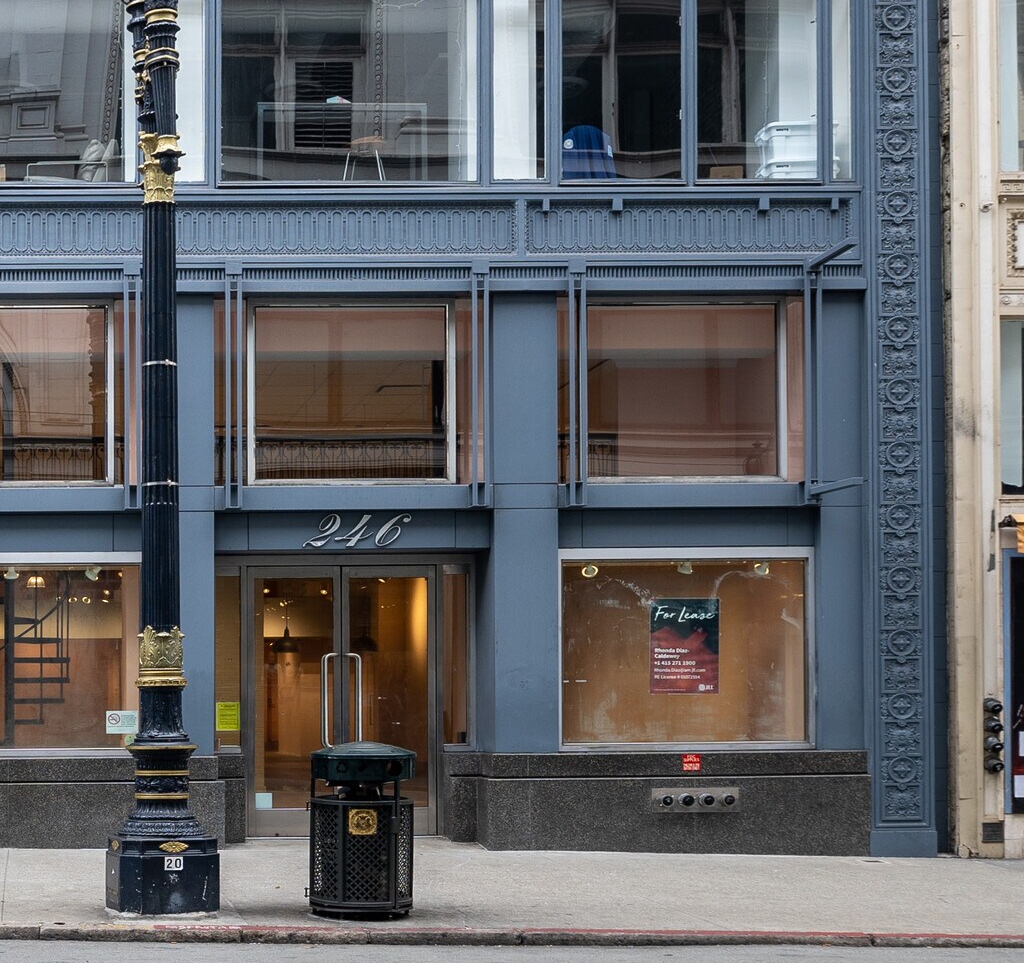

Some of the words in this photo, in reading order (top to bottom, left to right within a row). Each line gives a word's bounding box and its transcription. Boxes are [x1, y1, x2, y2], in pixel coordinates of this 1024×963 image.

[302, 513, 412, 547] 246
[654, 605, 675, 621] For
[678, 606, 715, 622] Lease
[166, 858, 182, 869] 20
